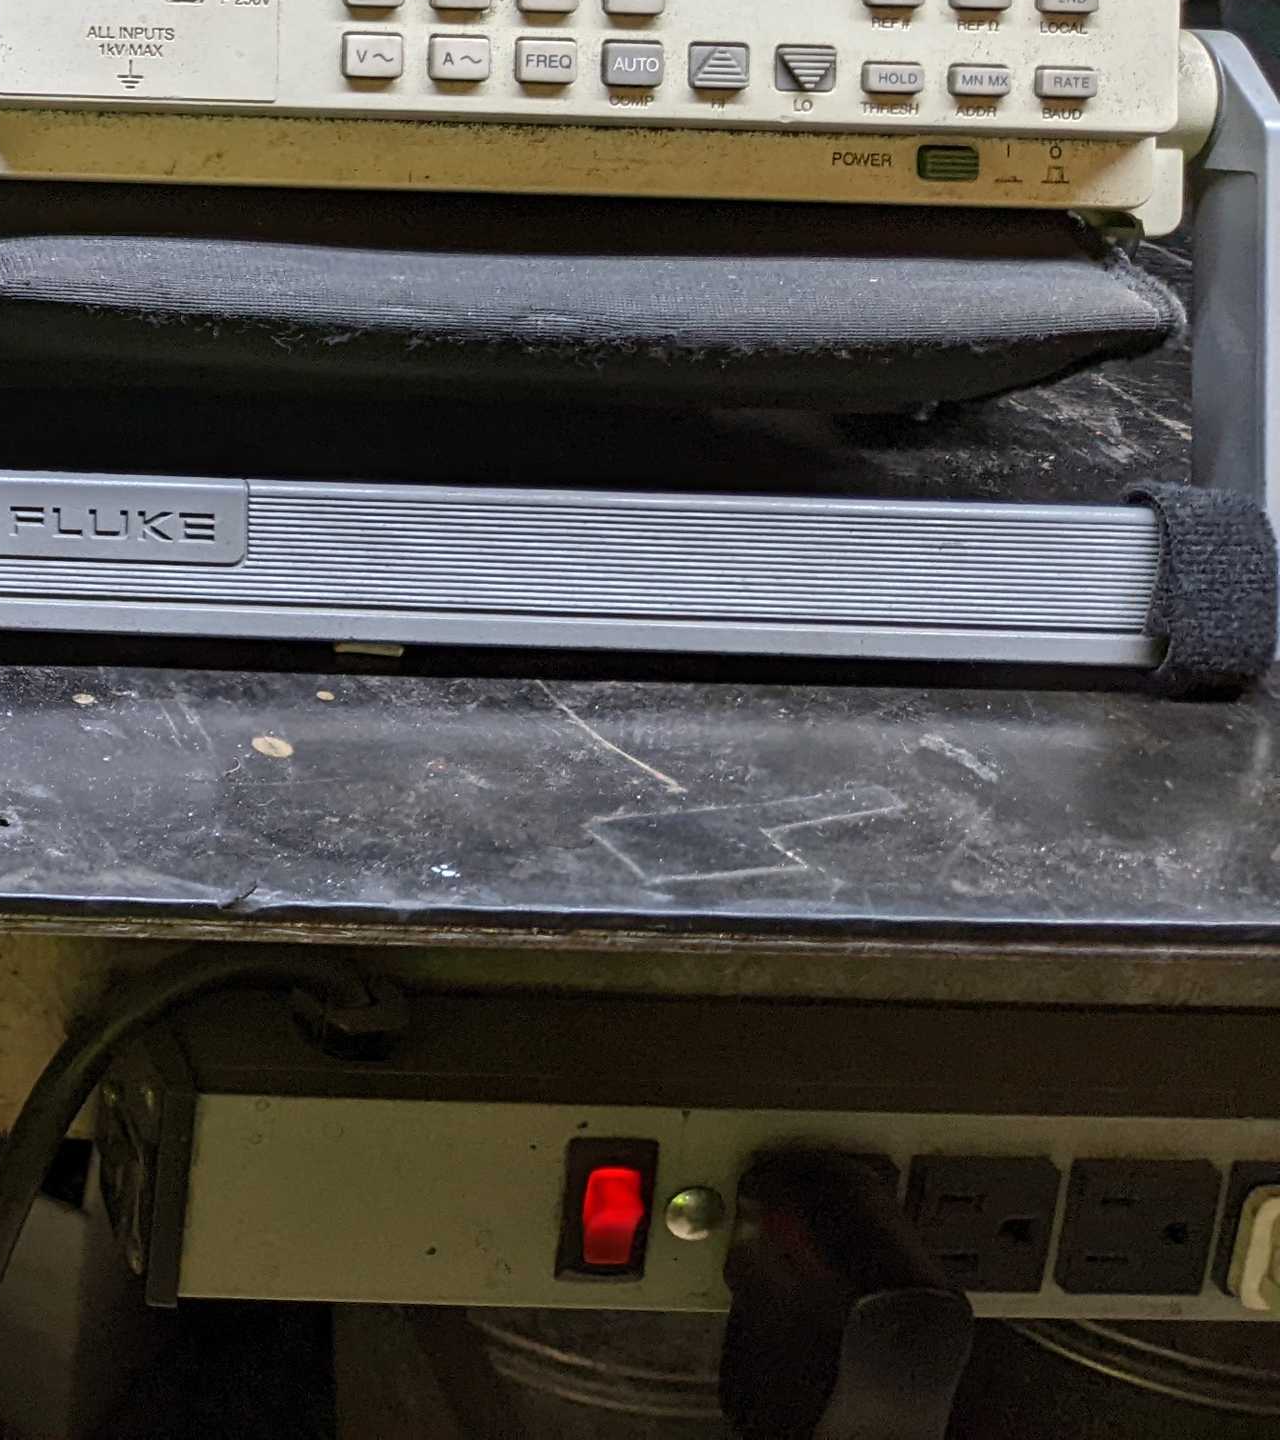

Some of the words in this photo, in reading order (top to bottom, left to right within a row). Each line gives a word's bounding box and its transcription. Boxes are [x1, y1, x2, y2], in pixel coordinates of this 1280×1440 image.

[86, 26, 114, 40] ALL
[117, 26, 175, 41] INPUTS
[1038, 21, 1089, 35] LOCAL
[98, 42, 127, 57] 1kV
[128, 43, 164, 58] MAX
[525, 53, 572, 71] FREQ
[613, 57, 659, 73] AUTO
[878, 71, 918, 86] HOLD
[961, 74, 984, 88] MN
[987, 74, 1009, 89] MX
[1052, 76, 1091, 90] RATE
[608, 94, 655, 108] COMP
[792, 99, 814, 112] LO
[861, 102, 920, 116] THRESH
[955, 104, 997, 119] ADDR
[1041, 107, 1083, 121] BAUD
[831, 152, 893, 167] POWER
[9, 505, 216, 544] FLUKE
